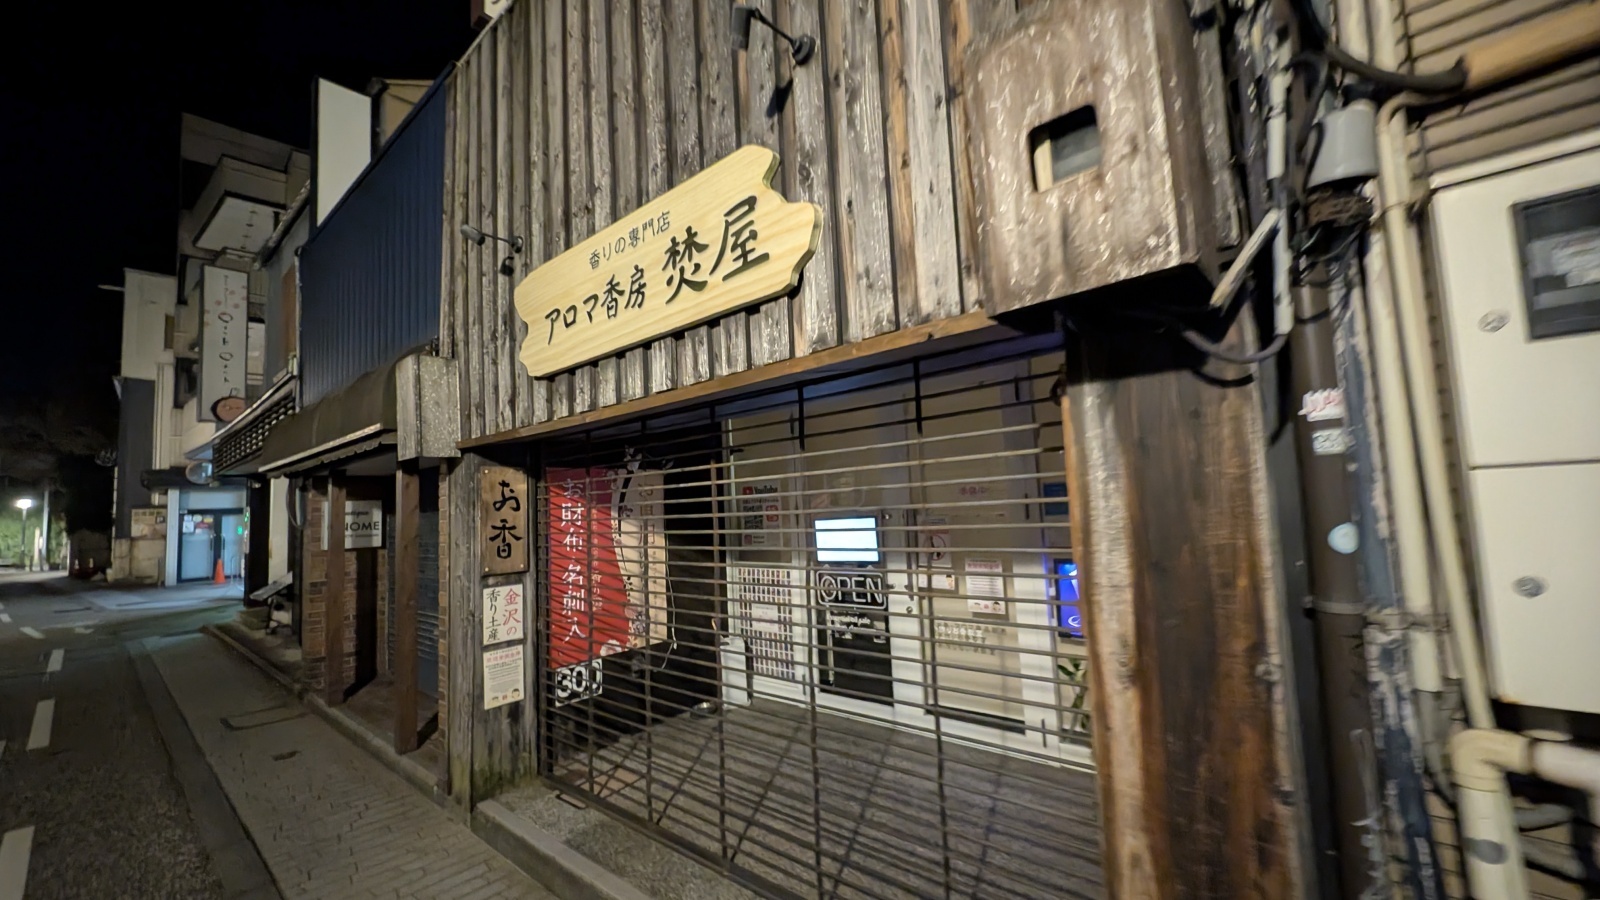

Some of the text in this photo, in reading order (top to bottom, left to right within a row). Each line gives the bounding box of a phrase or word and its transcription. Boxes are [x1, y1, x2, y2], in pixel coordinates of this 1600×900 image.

[588, 210, 671, 270] 香りの専門店
[544, 194, 770, 346] アロマ香房 焚屋
[488, 479, 523, 559] お香
[484, 587, 502, 643] 香り土産
[502, 587, 522, 636] 金沢の
[820, 575, 883, 604] OPEN
